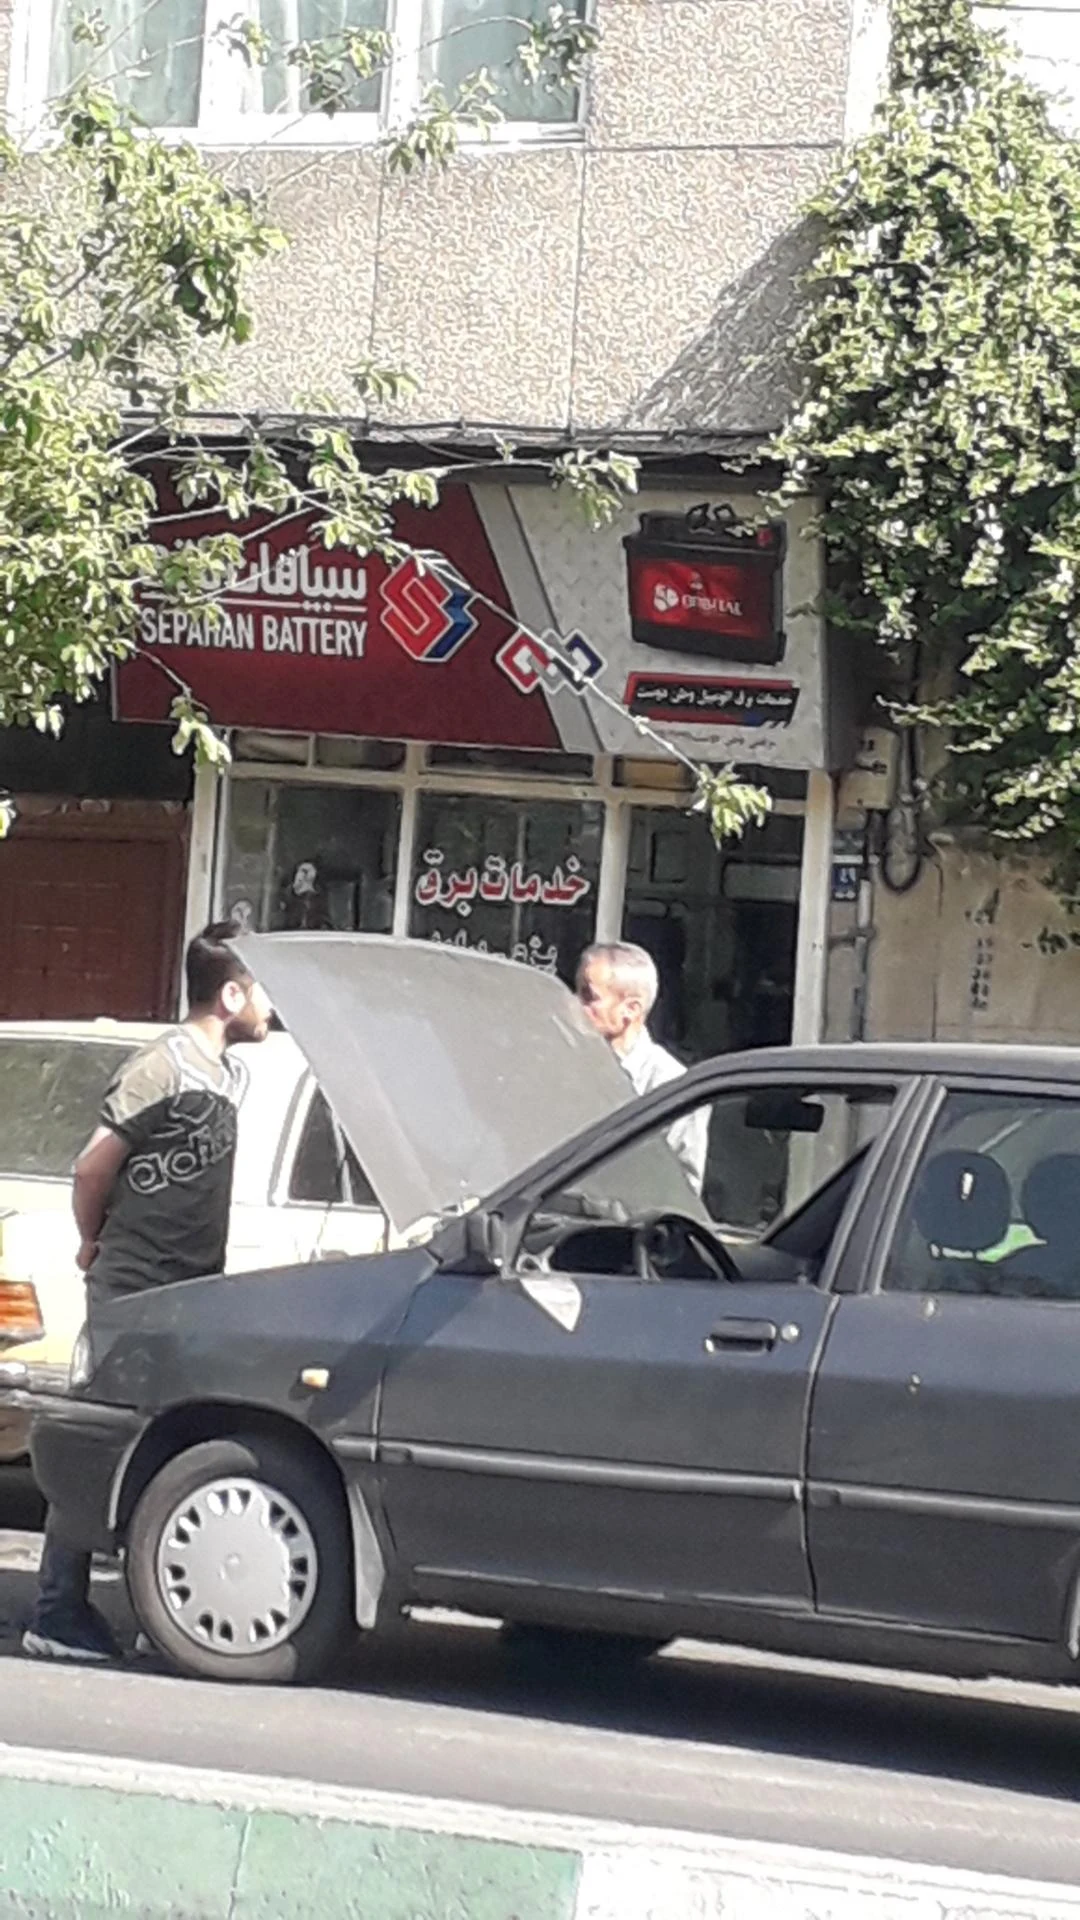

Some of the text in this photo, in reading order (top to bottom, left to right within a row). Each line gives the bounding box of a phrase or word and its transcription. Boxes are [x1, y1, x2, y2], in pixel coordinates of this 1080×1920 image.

[140, 607, 367, 657] SEPAHAN BATTERY
[415, 849, 591, 917] خدمات برق
